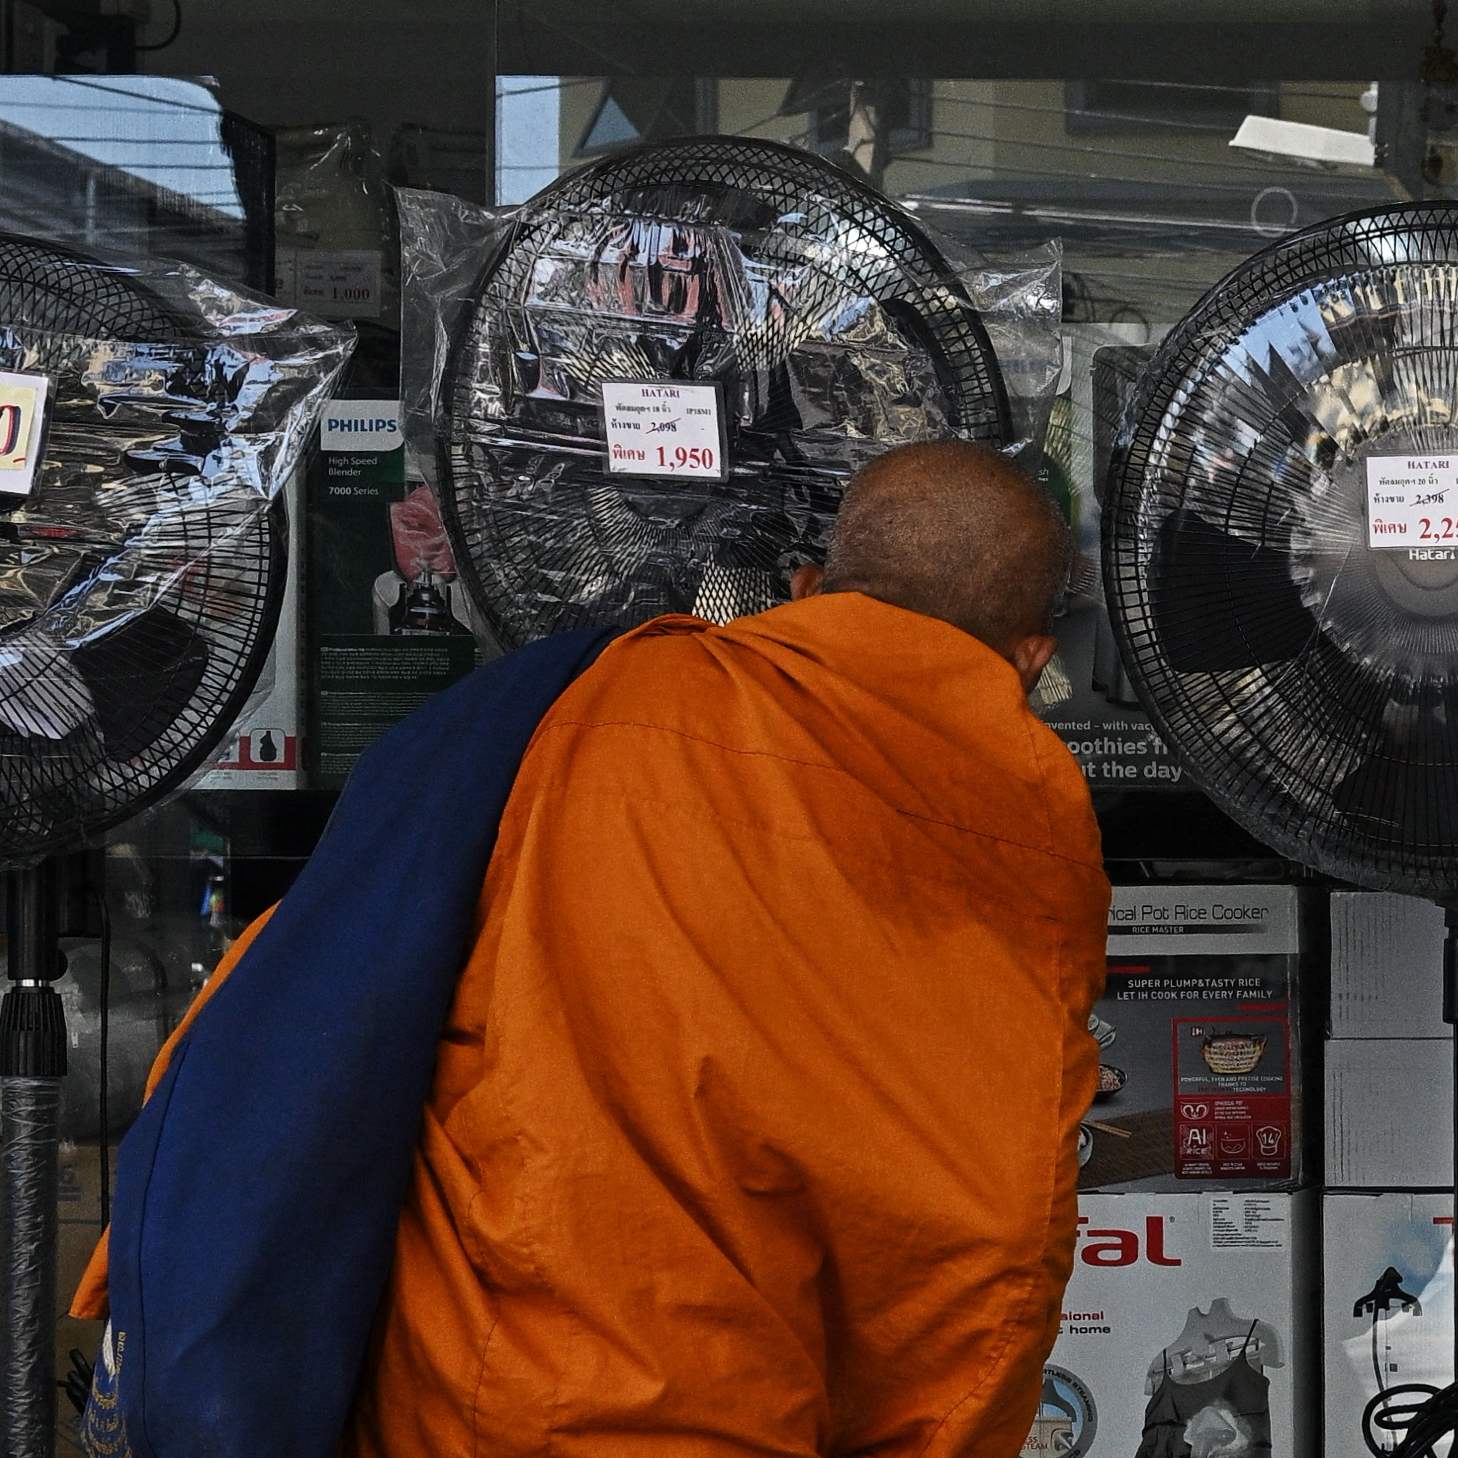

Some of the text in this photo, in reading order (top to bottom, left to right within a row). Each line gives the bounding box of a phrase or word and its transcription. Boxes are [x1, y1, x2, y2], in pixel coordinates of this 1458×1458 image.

[641, 388, 681, 398] HATARI
[327, 418, 397, 432] PHILIPS
[651, 422, 678, 432] 2,098
[328, 456, 379, 467] High Speed
[612, 443, 714, 472] พิเศษ 1,950
[1407, 461, 1450, 470] HATARI
[328, 468, 362, 477] Blender
[328, 486, 379, 496] 7000 Series
[1415, 494, 1445, 505] 2,398
[1372, 518, 1408, 535] พิเศษ
[1408, 547, 1456, 560] Hatari
[1102, 720, 1128, 731] with
[1066, 736, 1149, 755] oothies
[1101, 761, 1138, 778] the
[1143, 761, 1182, 783] day
[1110, 903, 1270, 921] rical Pot Rice Cooker
[1132, 926, 1184, 934] RICE MASTER
[1127, 977, 1261, 988] SUPER PLUMP&TASTY RICE
[1117, 990, 1273, 1000] LET IH COOK FOR EVERY FAMILY
[1069, 1325, 1111, 1335] home
